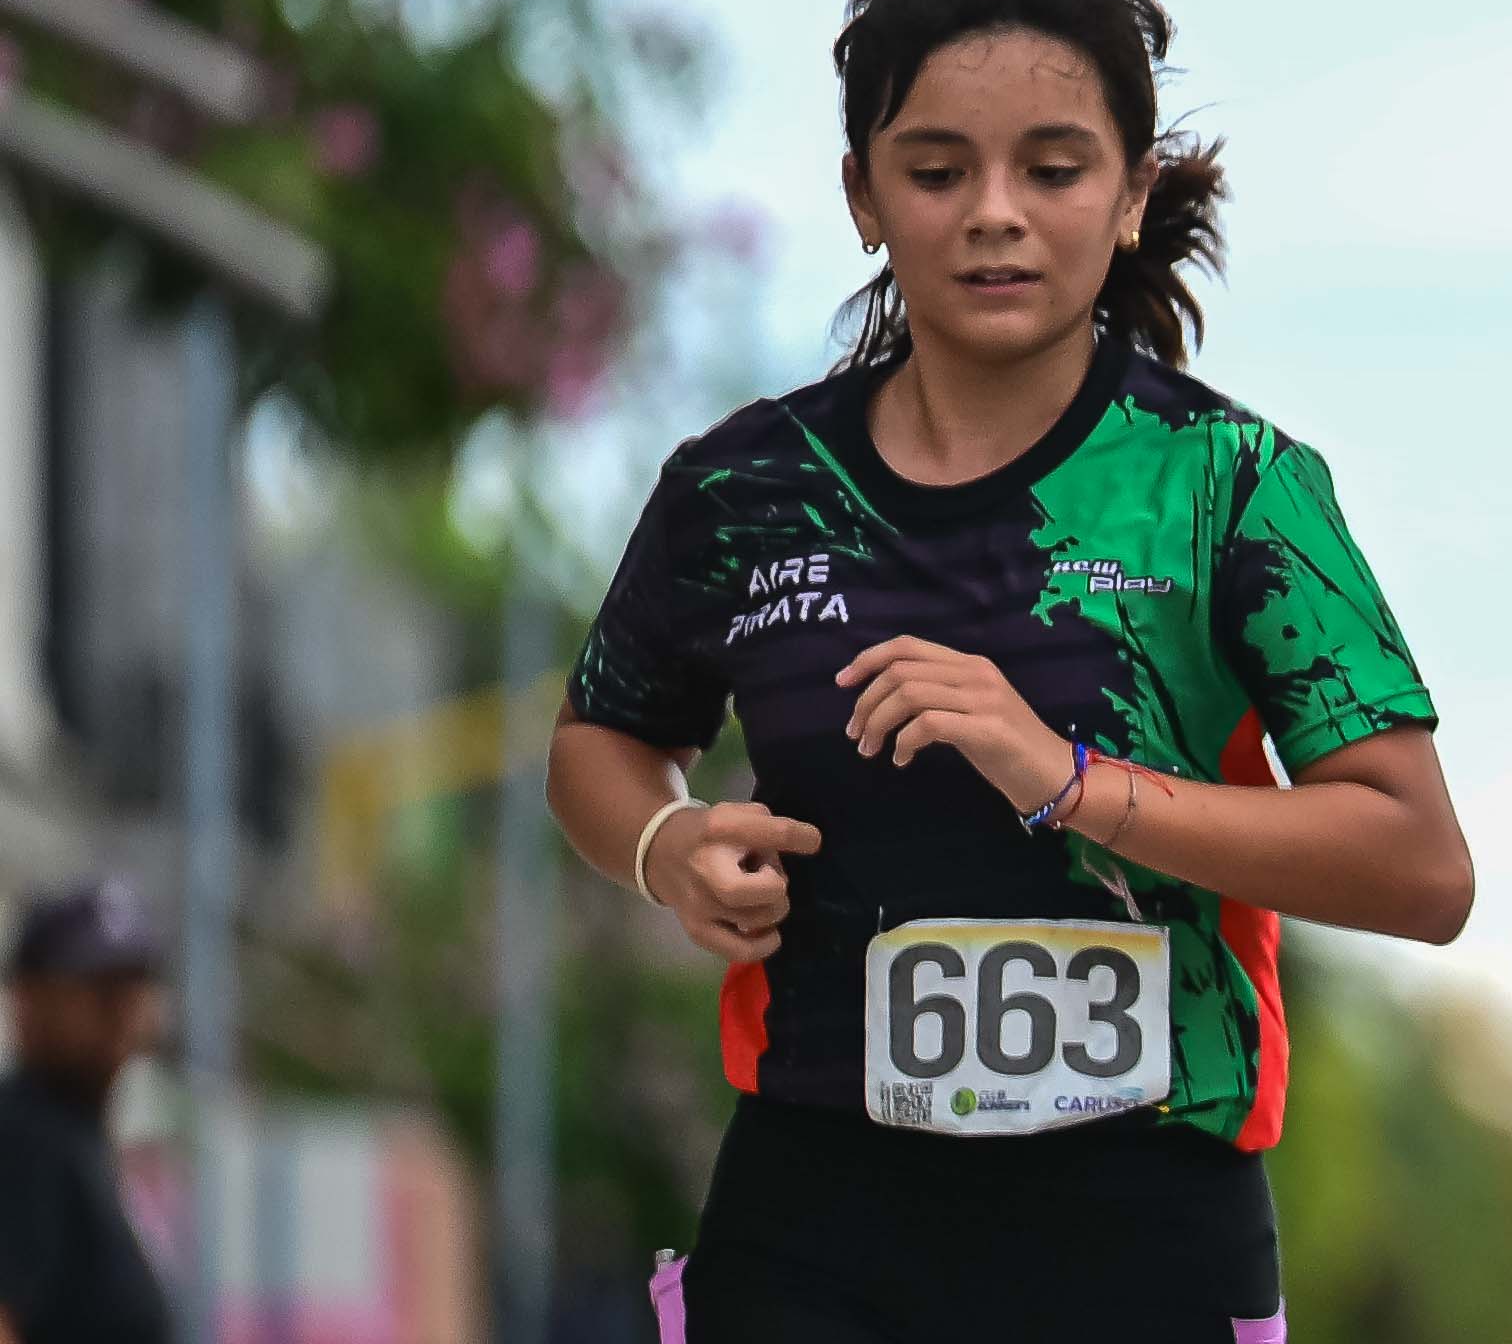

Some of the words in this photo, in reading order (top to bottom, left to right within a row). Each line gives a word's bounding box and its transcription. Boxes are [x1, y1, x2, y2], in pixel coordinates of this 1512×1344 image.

[749, 554, 829, 598] AIRE
[1089, 571, 1171, 593] play
[725, 592, 848, 645] PIRATA
[889, 941, 1142, 1078] 663
